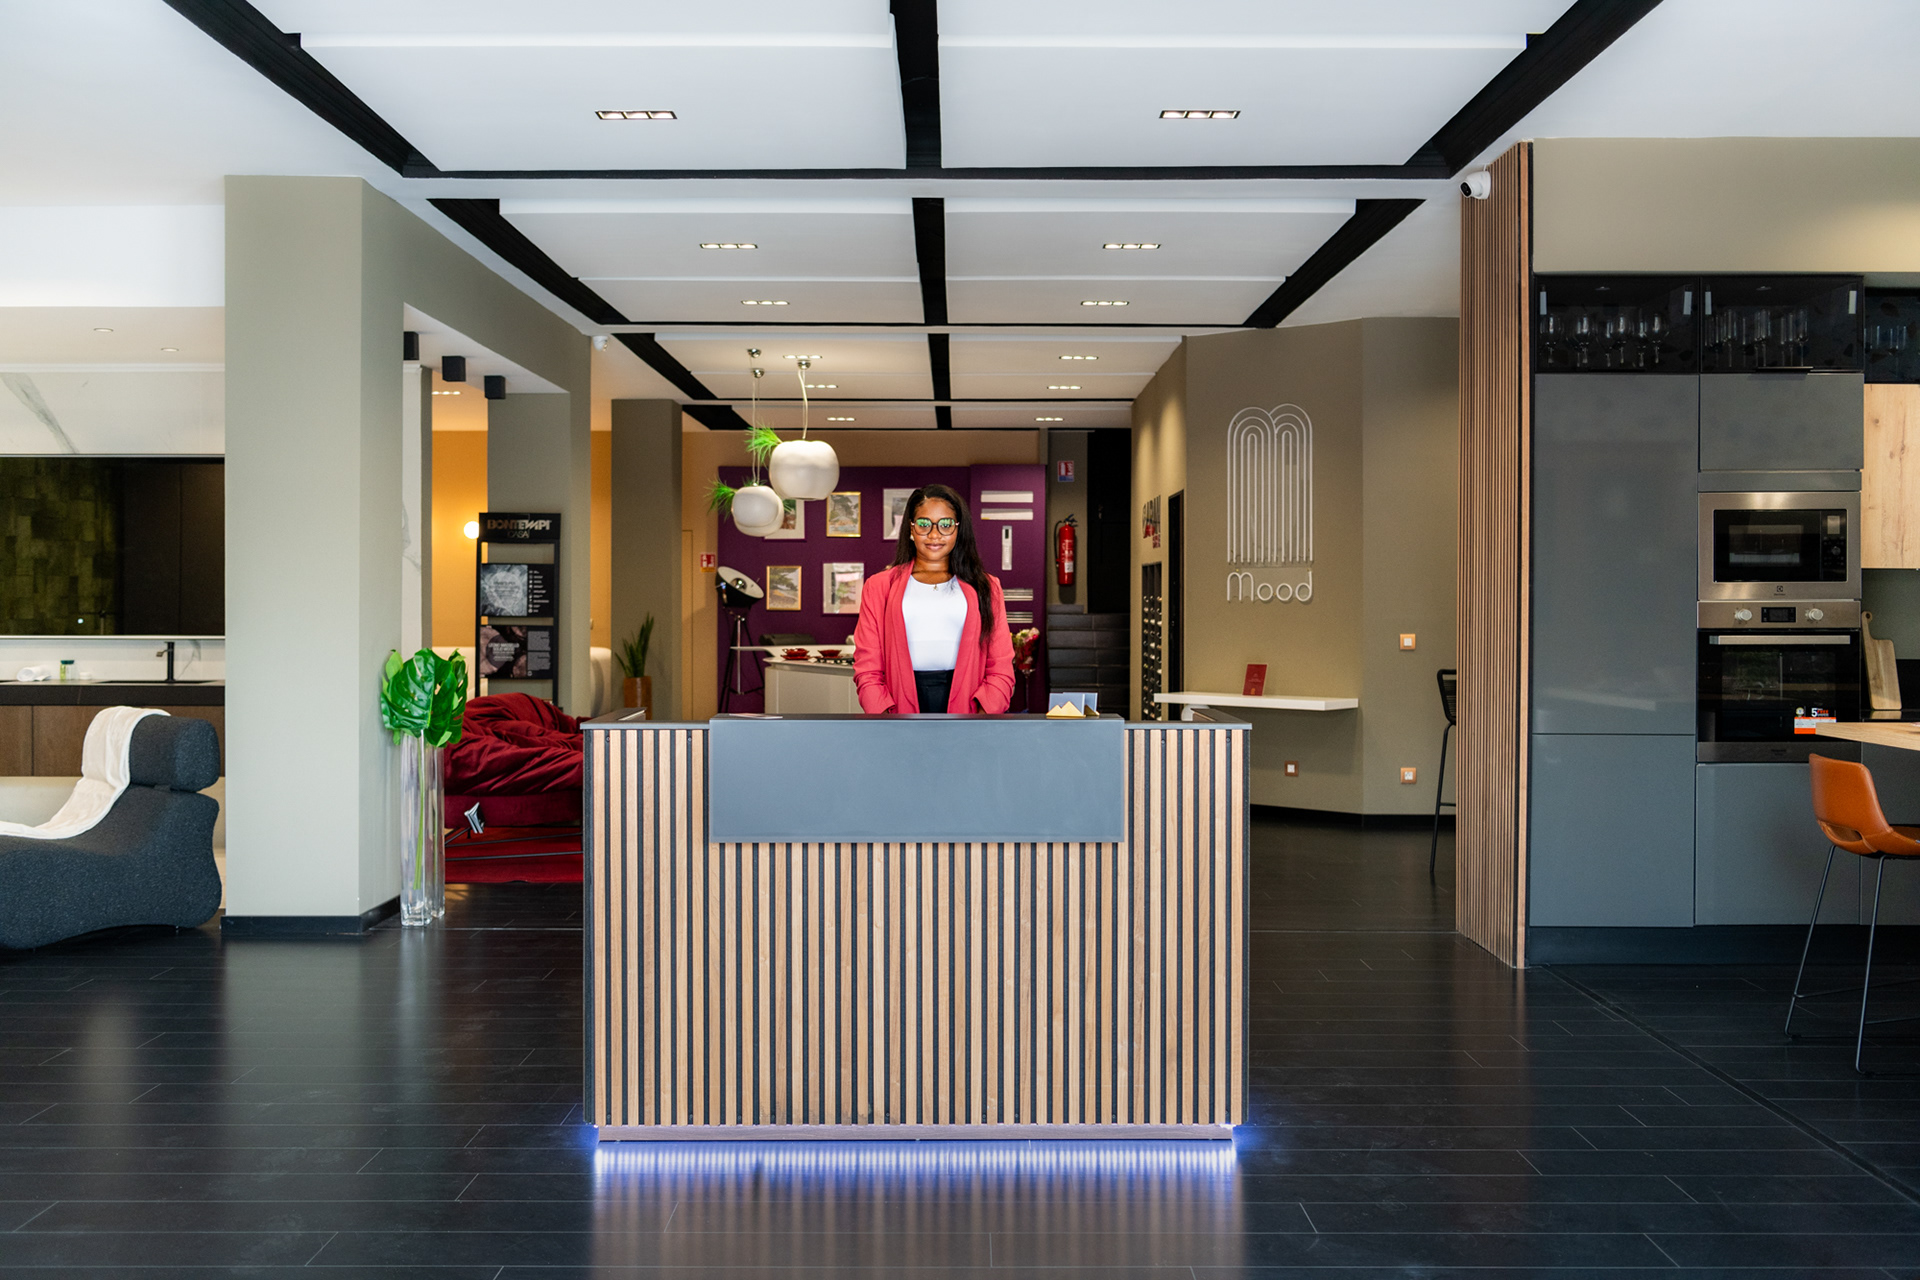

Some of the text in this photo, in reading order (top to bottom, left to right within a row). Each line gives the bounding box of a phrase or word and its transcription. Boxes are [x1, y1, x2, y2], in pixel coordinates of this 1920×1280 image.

[487, 519, 551, 530] BONTEMPI
[508, 530, 530, 539] CASA
[1811, 707, 1818, 717] 5
